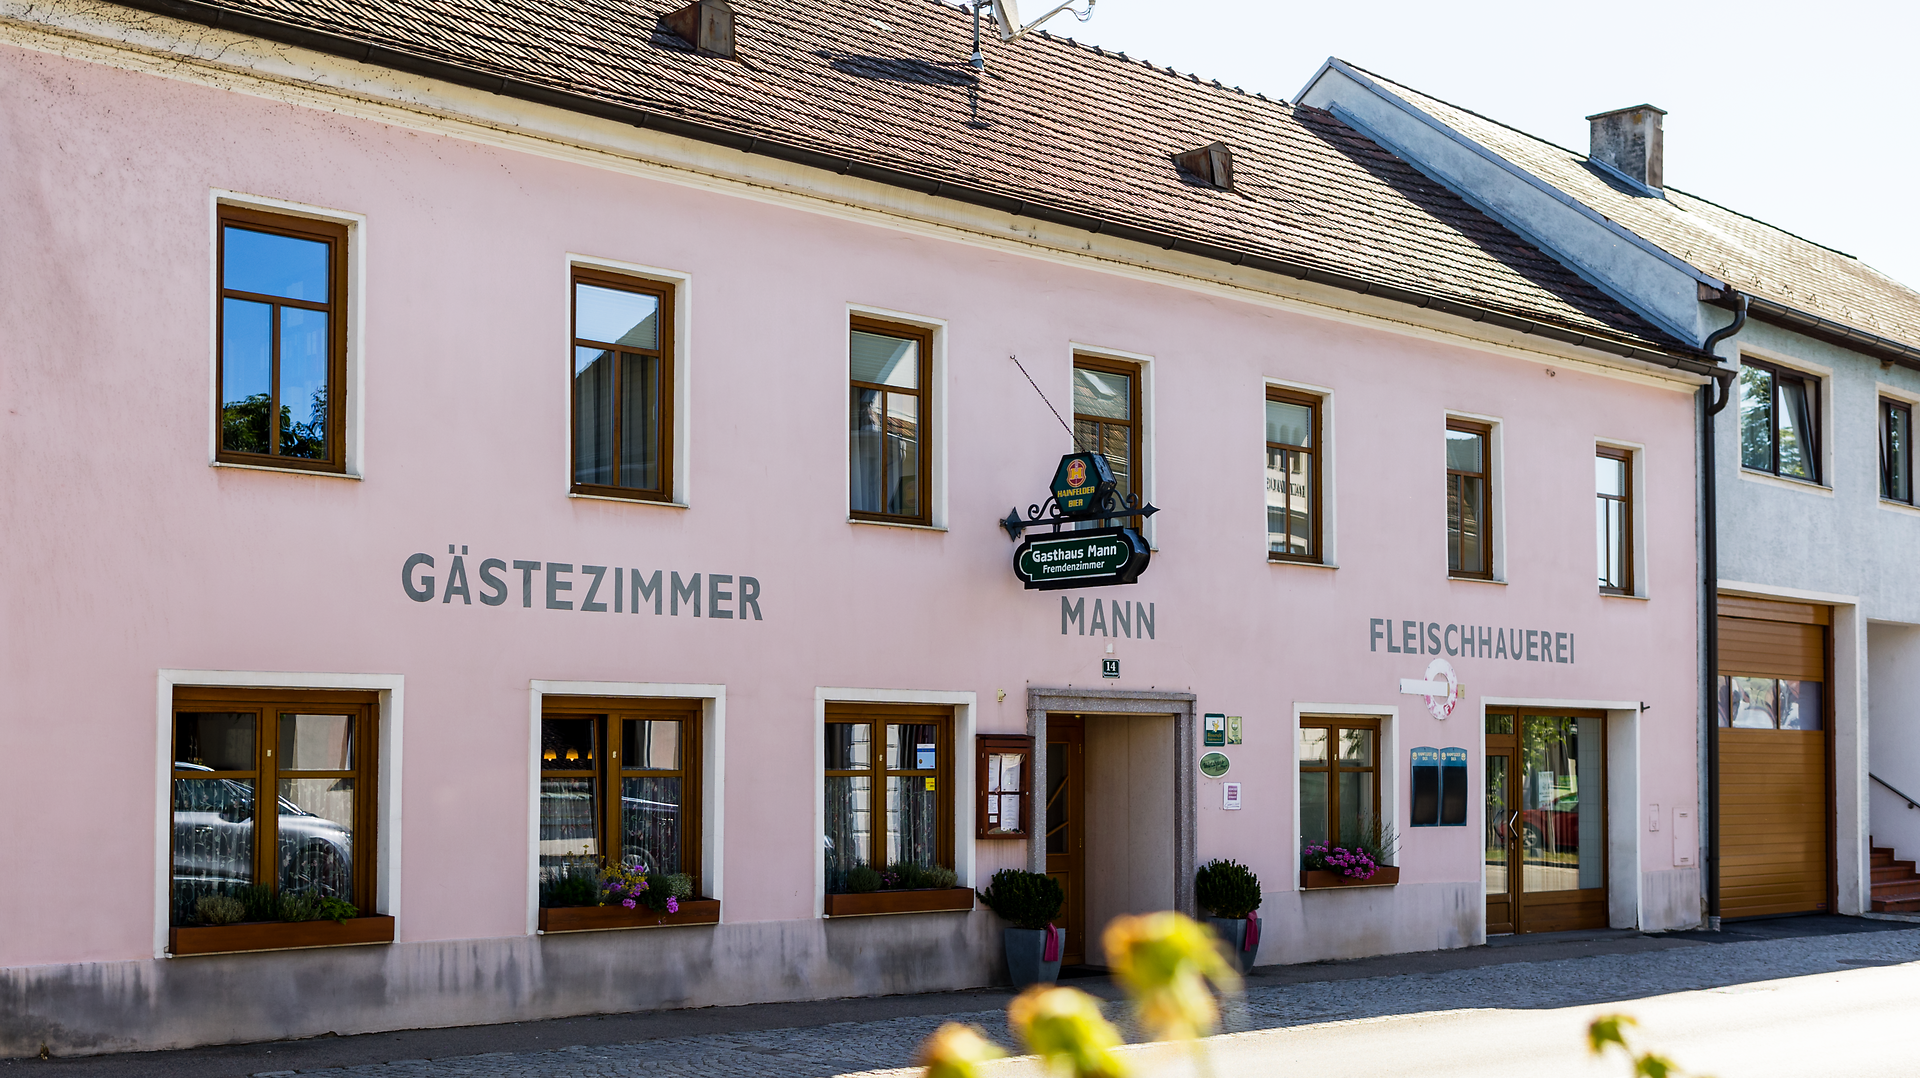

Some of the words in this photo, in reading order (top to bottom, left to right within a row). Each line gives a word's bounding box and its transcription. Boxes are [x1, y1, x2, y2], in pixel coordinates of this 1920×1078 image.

[1057, 486, 1096, 498] HAINFELDER
[1068, 499, 1084, 508] BIER
[1032, 548, 1084, 563] Gasthaus
[1087, 545, 1117, 558] Mann
[1042, 560, 1105, 574] Fremdenzimmer
[402, 544, 763, 620] GÄSTEZIMMER
[1061, 596, 1155, 640] MANN
[1370, 618, 1574, 664] FLEISCHHAUEREI
[1106, 661, 1117, 672] 14
